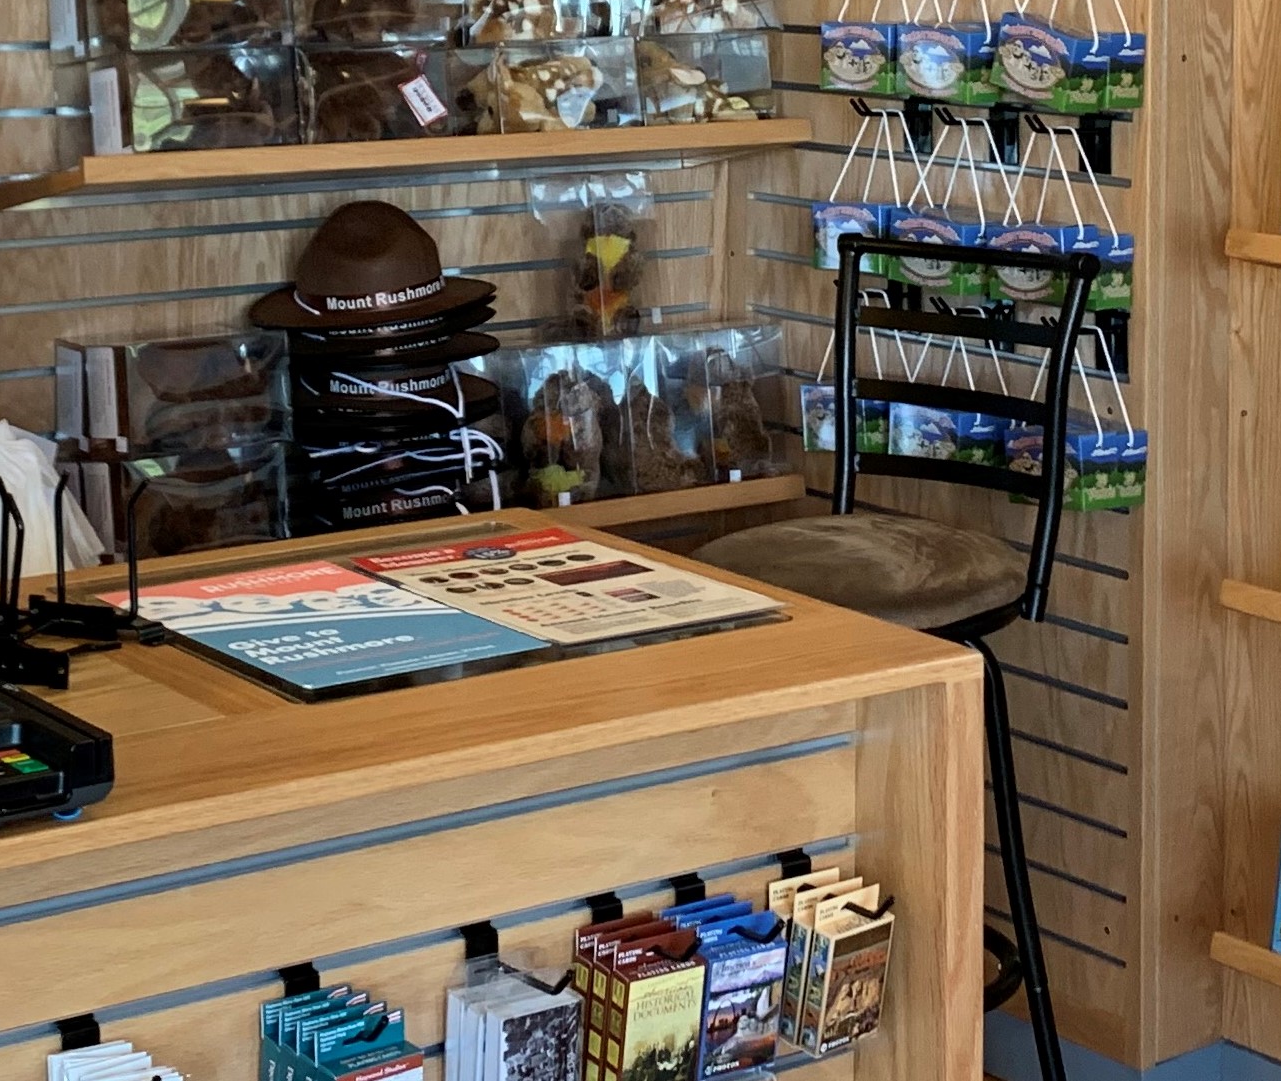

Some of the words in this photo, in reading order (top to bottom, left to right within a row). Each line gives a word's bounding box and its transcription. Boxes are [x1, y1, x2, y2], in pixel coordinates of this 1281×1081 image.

[326, 295, 373, 310] Mount
[330, 379, 375, 395] Mount
[343, 501, 388, 520] Mount
[199, 567, 344, 595] RUSHMORE
[228, 634, 301, 652] Give
[306, 628, 340, 638] to
[244, 636, 344, 659] Mount
[259, 635, 416, 666] Rushmore
[618, 948, 643, 958] PLAYING
[633, 999, 697, 1022] DOCUMENTS
[636, 989, 695, 1011] HISTORICAL
